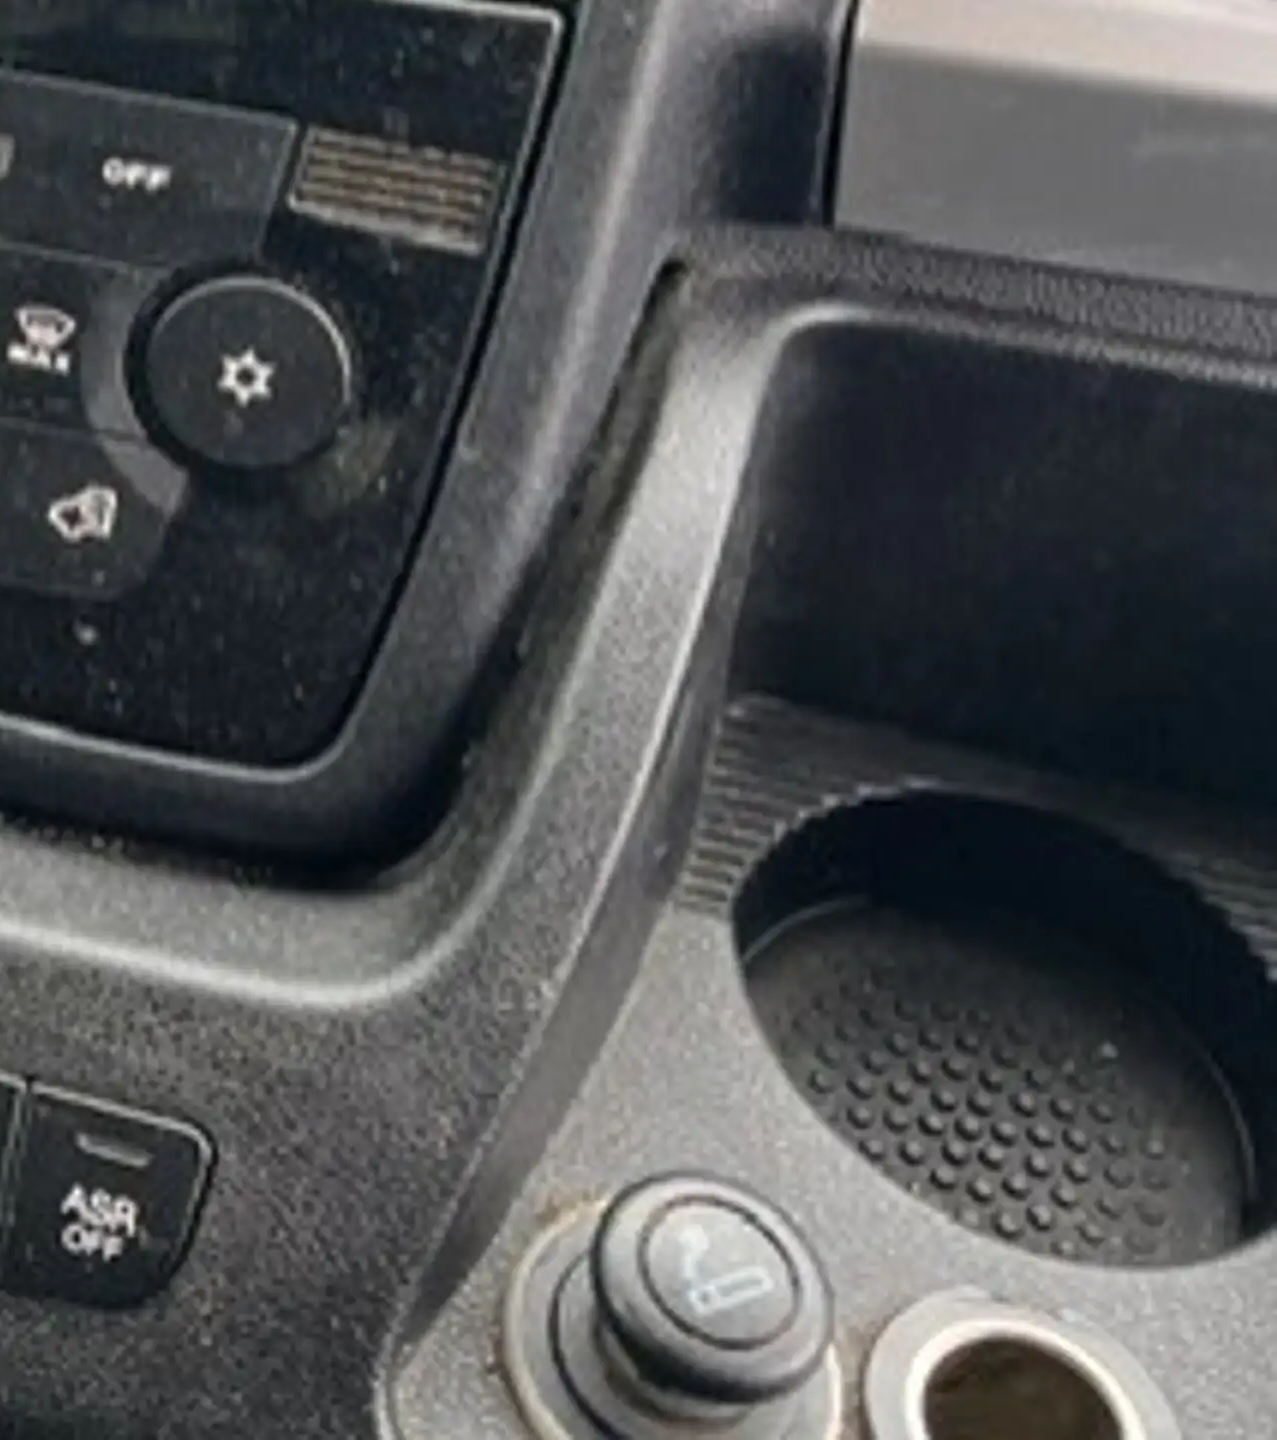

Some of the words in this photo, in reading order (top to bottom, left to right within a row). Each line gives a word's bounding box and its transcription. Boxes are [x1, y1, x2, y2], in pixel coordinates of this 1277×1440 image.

[101, 157, 172, 191] OFF
[60, 1182, 138, 1238] ASR
[61, 1223, 124, 1262] OFF
